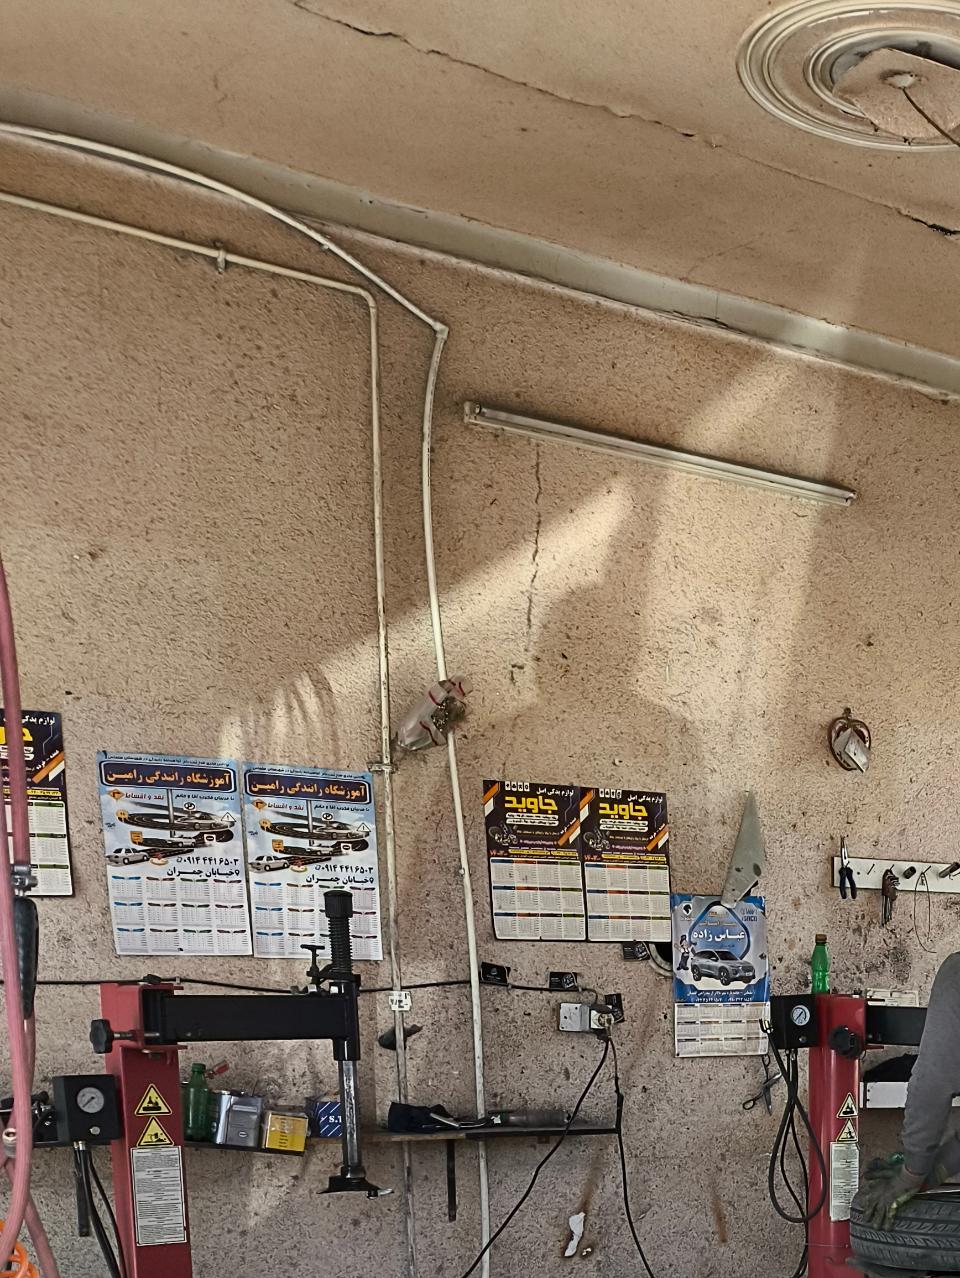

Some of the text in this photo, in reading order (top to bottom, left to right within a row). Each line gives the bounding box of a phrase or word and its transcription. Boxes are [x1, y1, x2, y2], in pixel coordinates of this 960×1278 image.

[106, 769, 230, 788] آموزشگاه رانندگی رامین
[251, 780, 365, 799] آموزشگاه رانندگی رامین
[504, 795, 558, 814] جاوید
[599, 802, 648, 820] جاوید
[205, 868, 234, 878] خیابان
[342, 875, 369, 886] خیابان
[693, 928, 745, 942] عباس زاده
